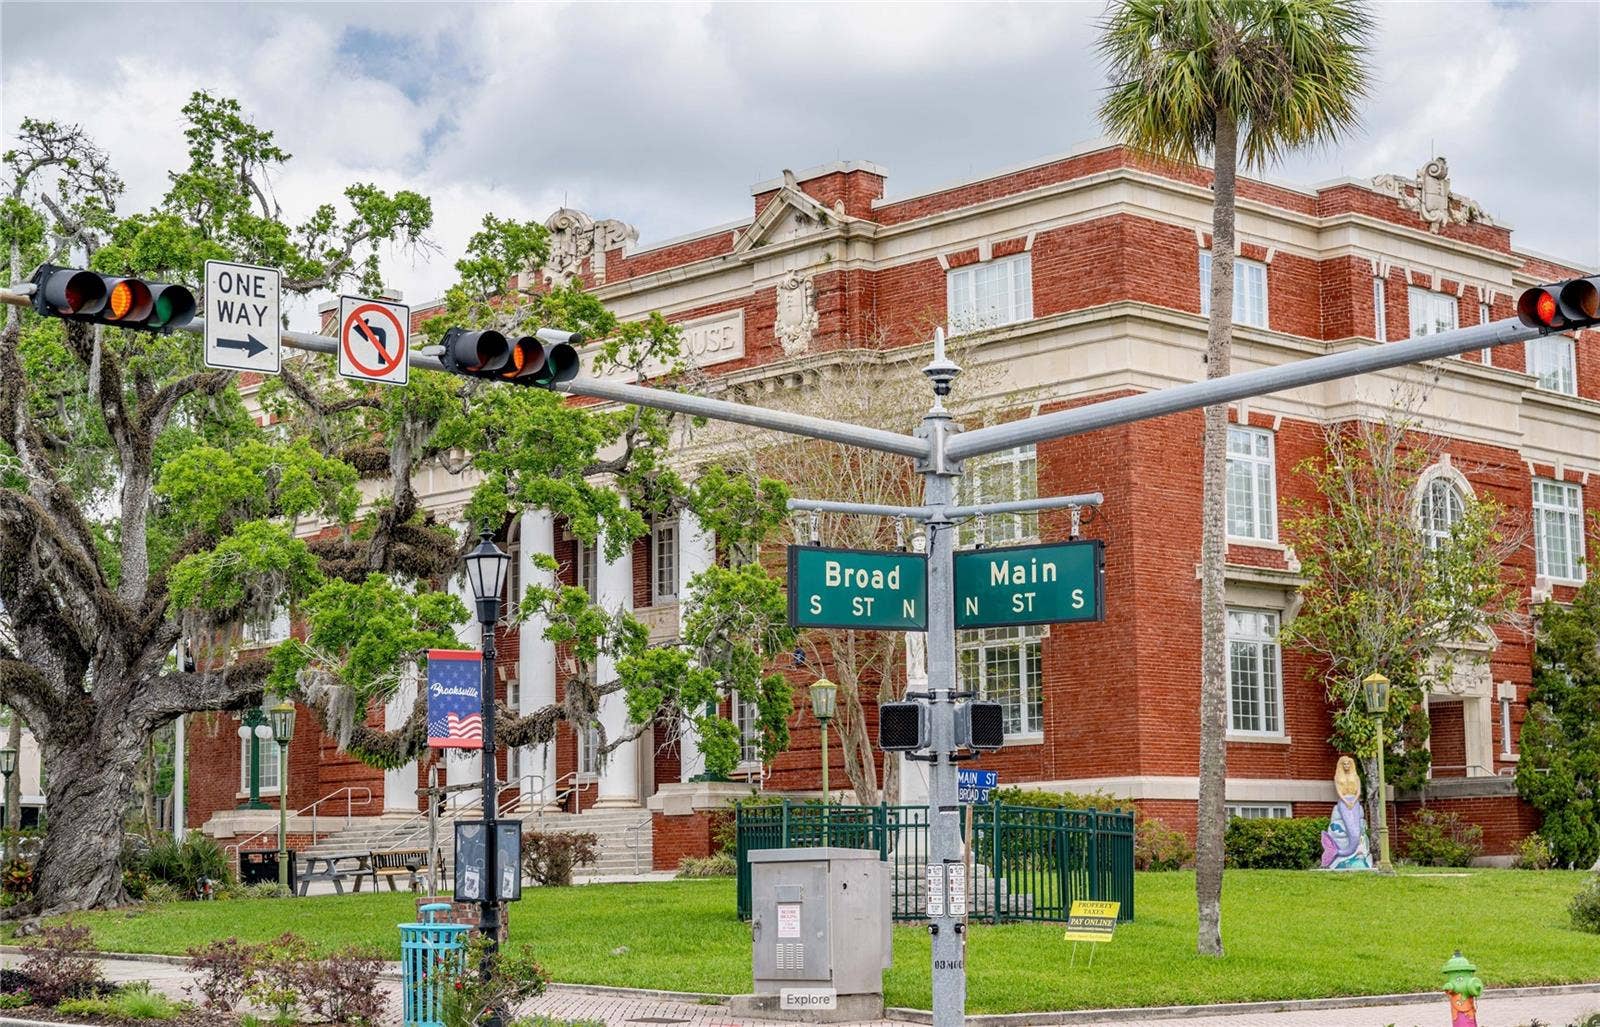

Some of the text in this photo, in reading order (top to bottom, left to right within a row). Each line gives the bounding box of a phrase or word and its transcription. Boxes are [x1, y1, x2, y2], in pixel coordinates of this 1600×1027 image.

[219, 271, 266, 298] ONE
[217, 300, 268, 327] WAY
[679, 326, 735, 359] OUSE
[825, 560, 901, 590] Broad
[990, 557, 1057, 586] Main
[810, 594, 915, 618] S ST N
[965, 589, 1085, 616] N ST S
[430, 682, 479, 698] Brooksville
[958, 771, 997, 786] MAIN ST
[960, 788, 989, 802] BROAD ST
